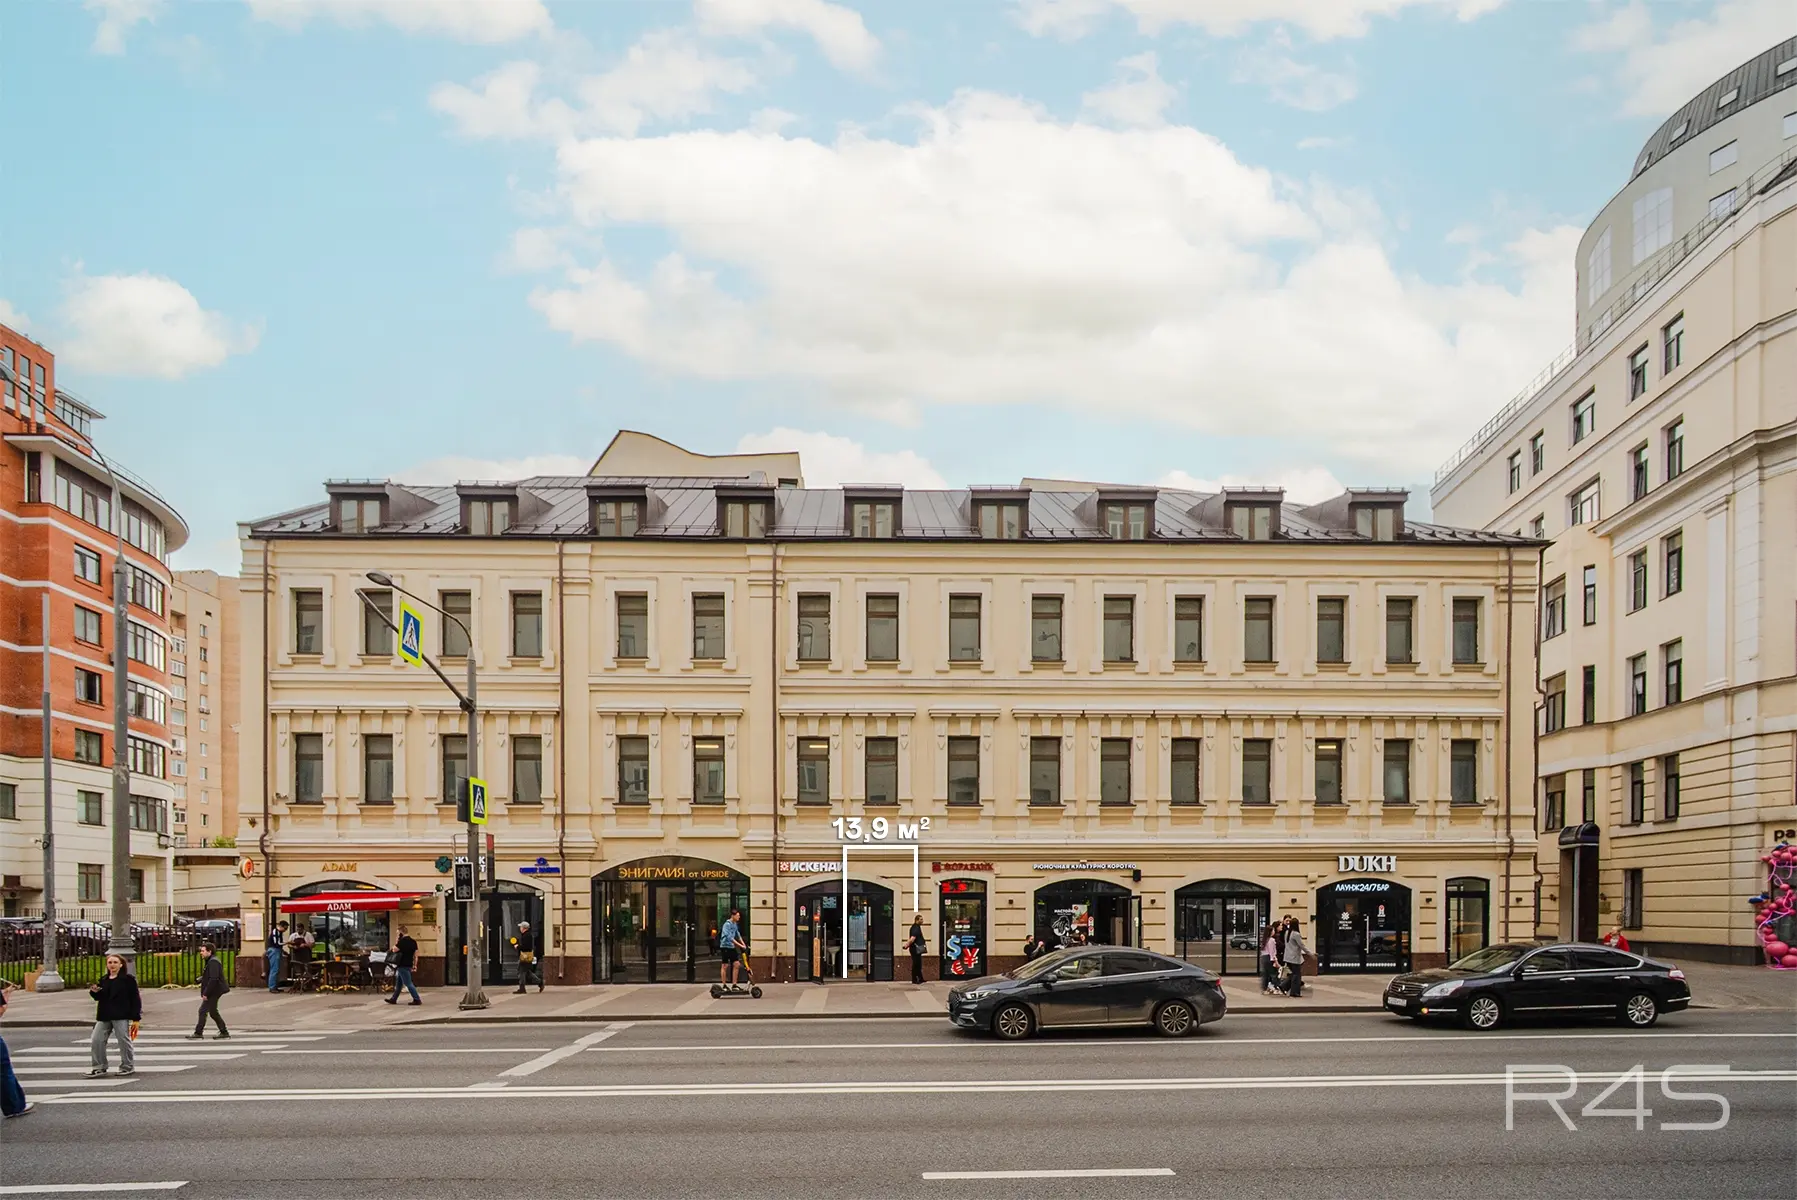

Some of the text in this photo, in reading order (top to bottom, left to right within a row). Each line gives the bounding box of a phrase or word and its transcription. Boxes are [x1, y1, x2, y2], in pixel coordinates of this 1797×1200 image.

[321, 862, 358, 872] ADAM
[1338, 855, 1397, 872] DUKH
[618, 867, 685, 879] ЭНИГМИЯ
[701, 870, 729, 878] UPSIDE
[327, 903, 351, 911] ADAM
